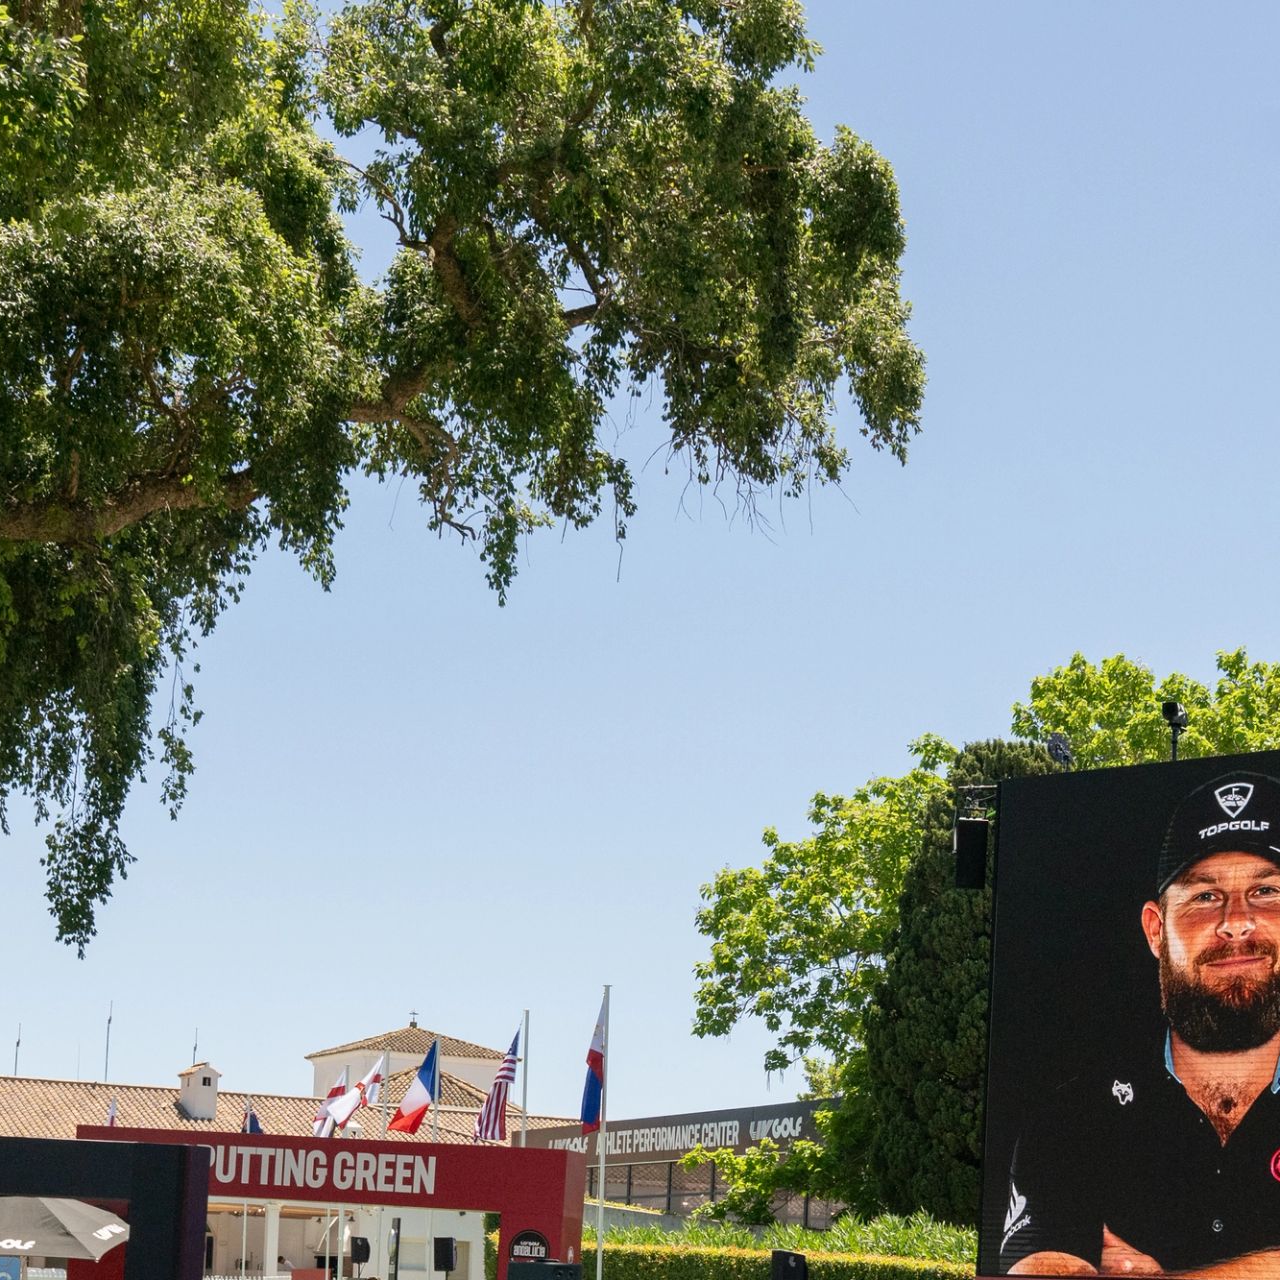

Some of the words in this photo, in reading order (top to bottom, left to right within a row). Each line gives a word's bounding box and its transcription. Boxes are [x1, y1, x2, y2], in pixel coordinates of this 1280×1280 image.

[1198, 820, 1270, 839] TOPGOLF
[633, 1124, 701, 1153] PERFORMANCE
[702, 1120, 739, 1148] CENTER
[333, 1151, 437, 1195] GREEN
